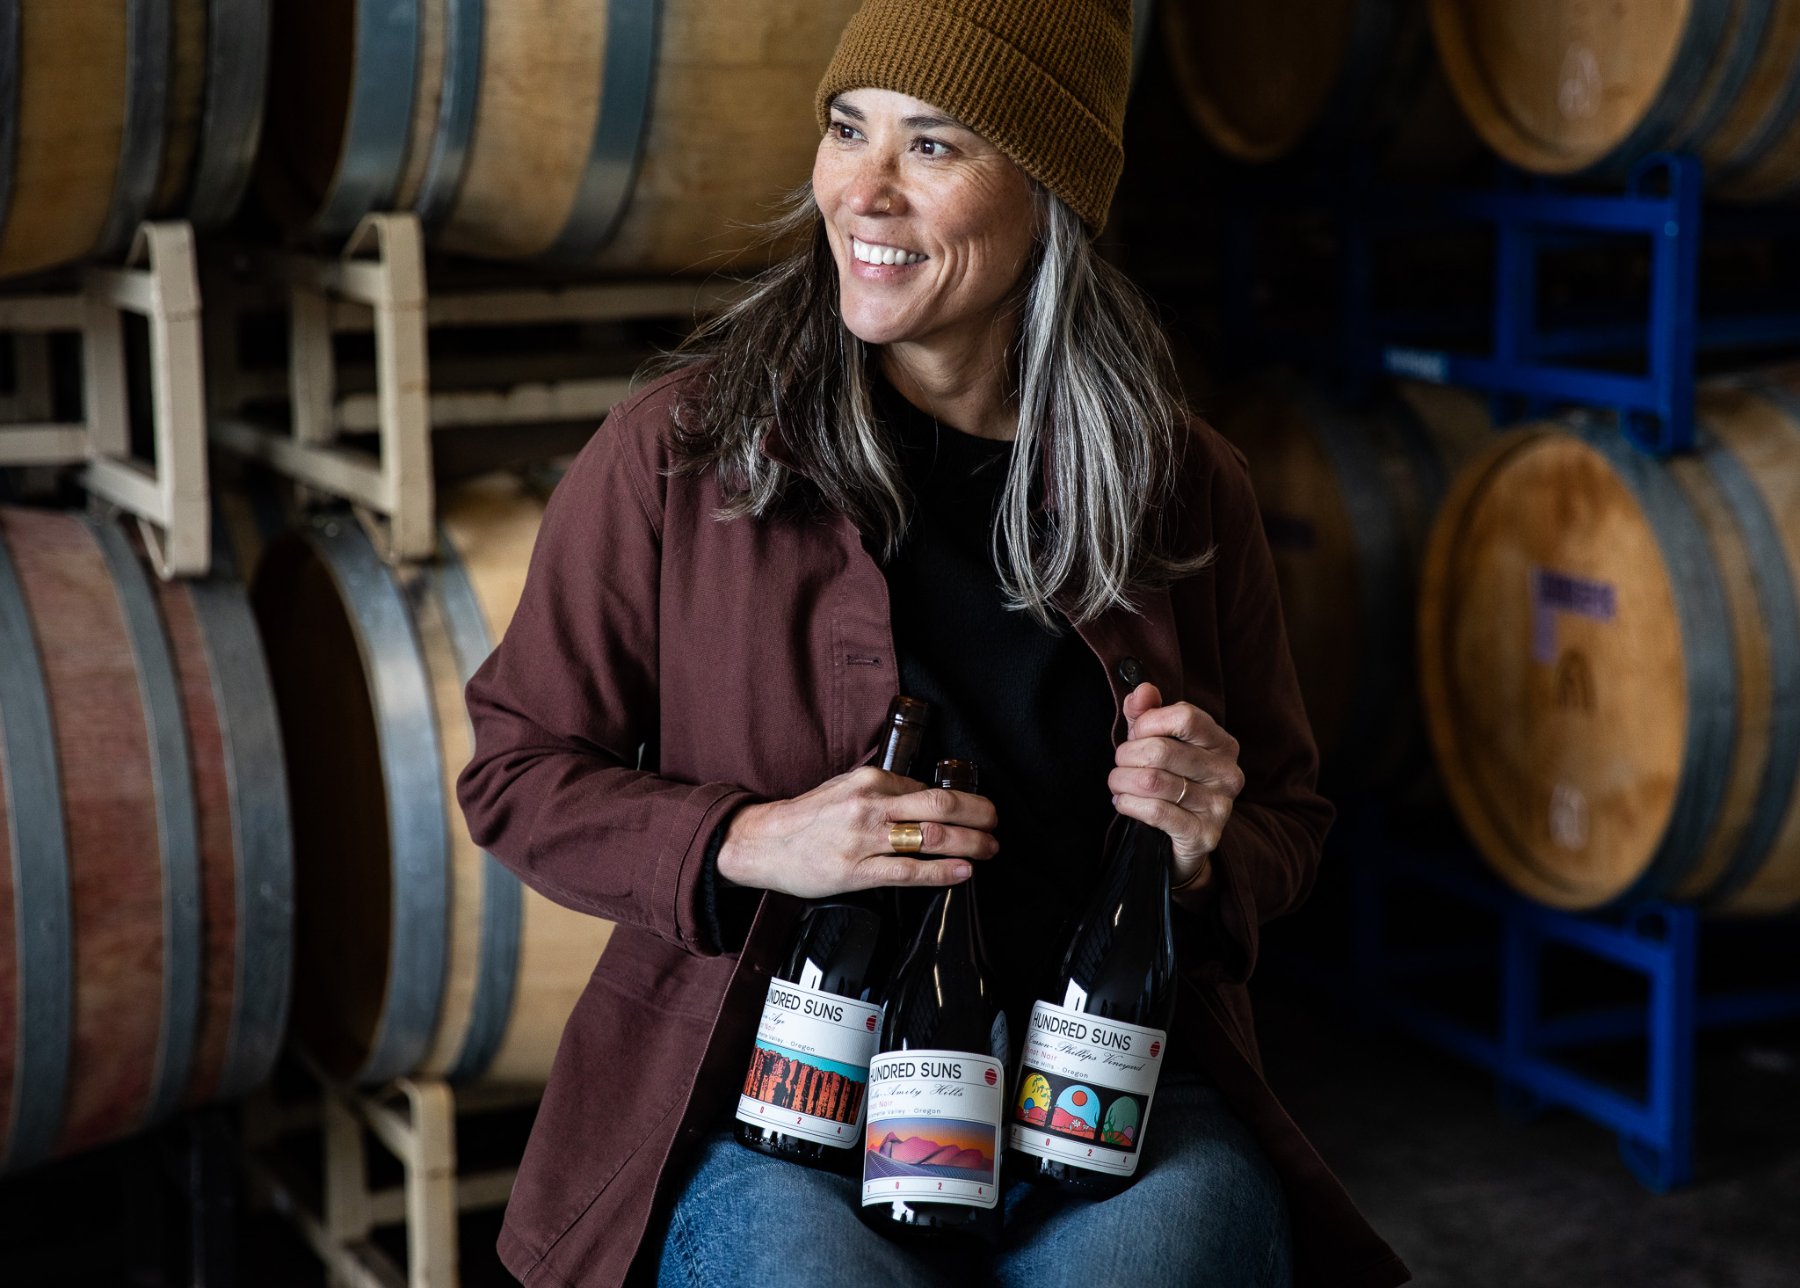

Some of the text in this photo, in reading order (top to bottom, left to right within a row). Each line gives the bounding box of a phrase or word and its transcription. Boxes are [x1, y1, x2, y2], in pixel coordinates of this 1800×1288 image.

[803, 999, 844, 1022] SUNS
[1032, 1011, 1087, 1040] HUNDRED
[1091, 1028, 1132, 1051] SUNS
[790, 1041, 815, 1052] Oregon
[1103, 1052, 1146, 1072] Vineyard
[920, 1062, 962, 1079] SUNS
[1062, 1066, 1089, 1079] Oregon
[930, 1083, 963, 1097] Hills
[913, 1107, 941, 1115] Oregon
[796, 1116, 803, 1125] 2
[1087, 1149, 1093, 1157] 2
[895, 1181, 900, 1190] 0
[937, 1182, 943, 1191] 2
[977, 1187, 983, 1195] 4
